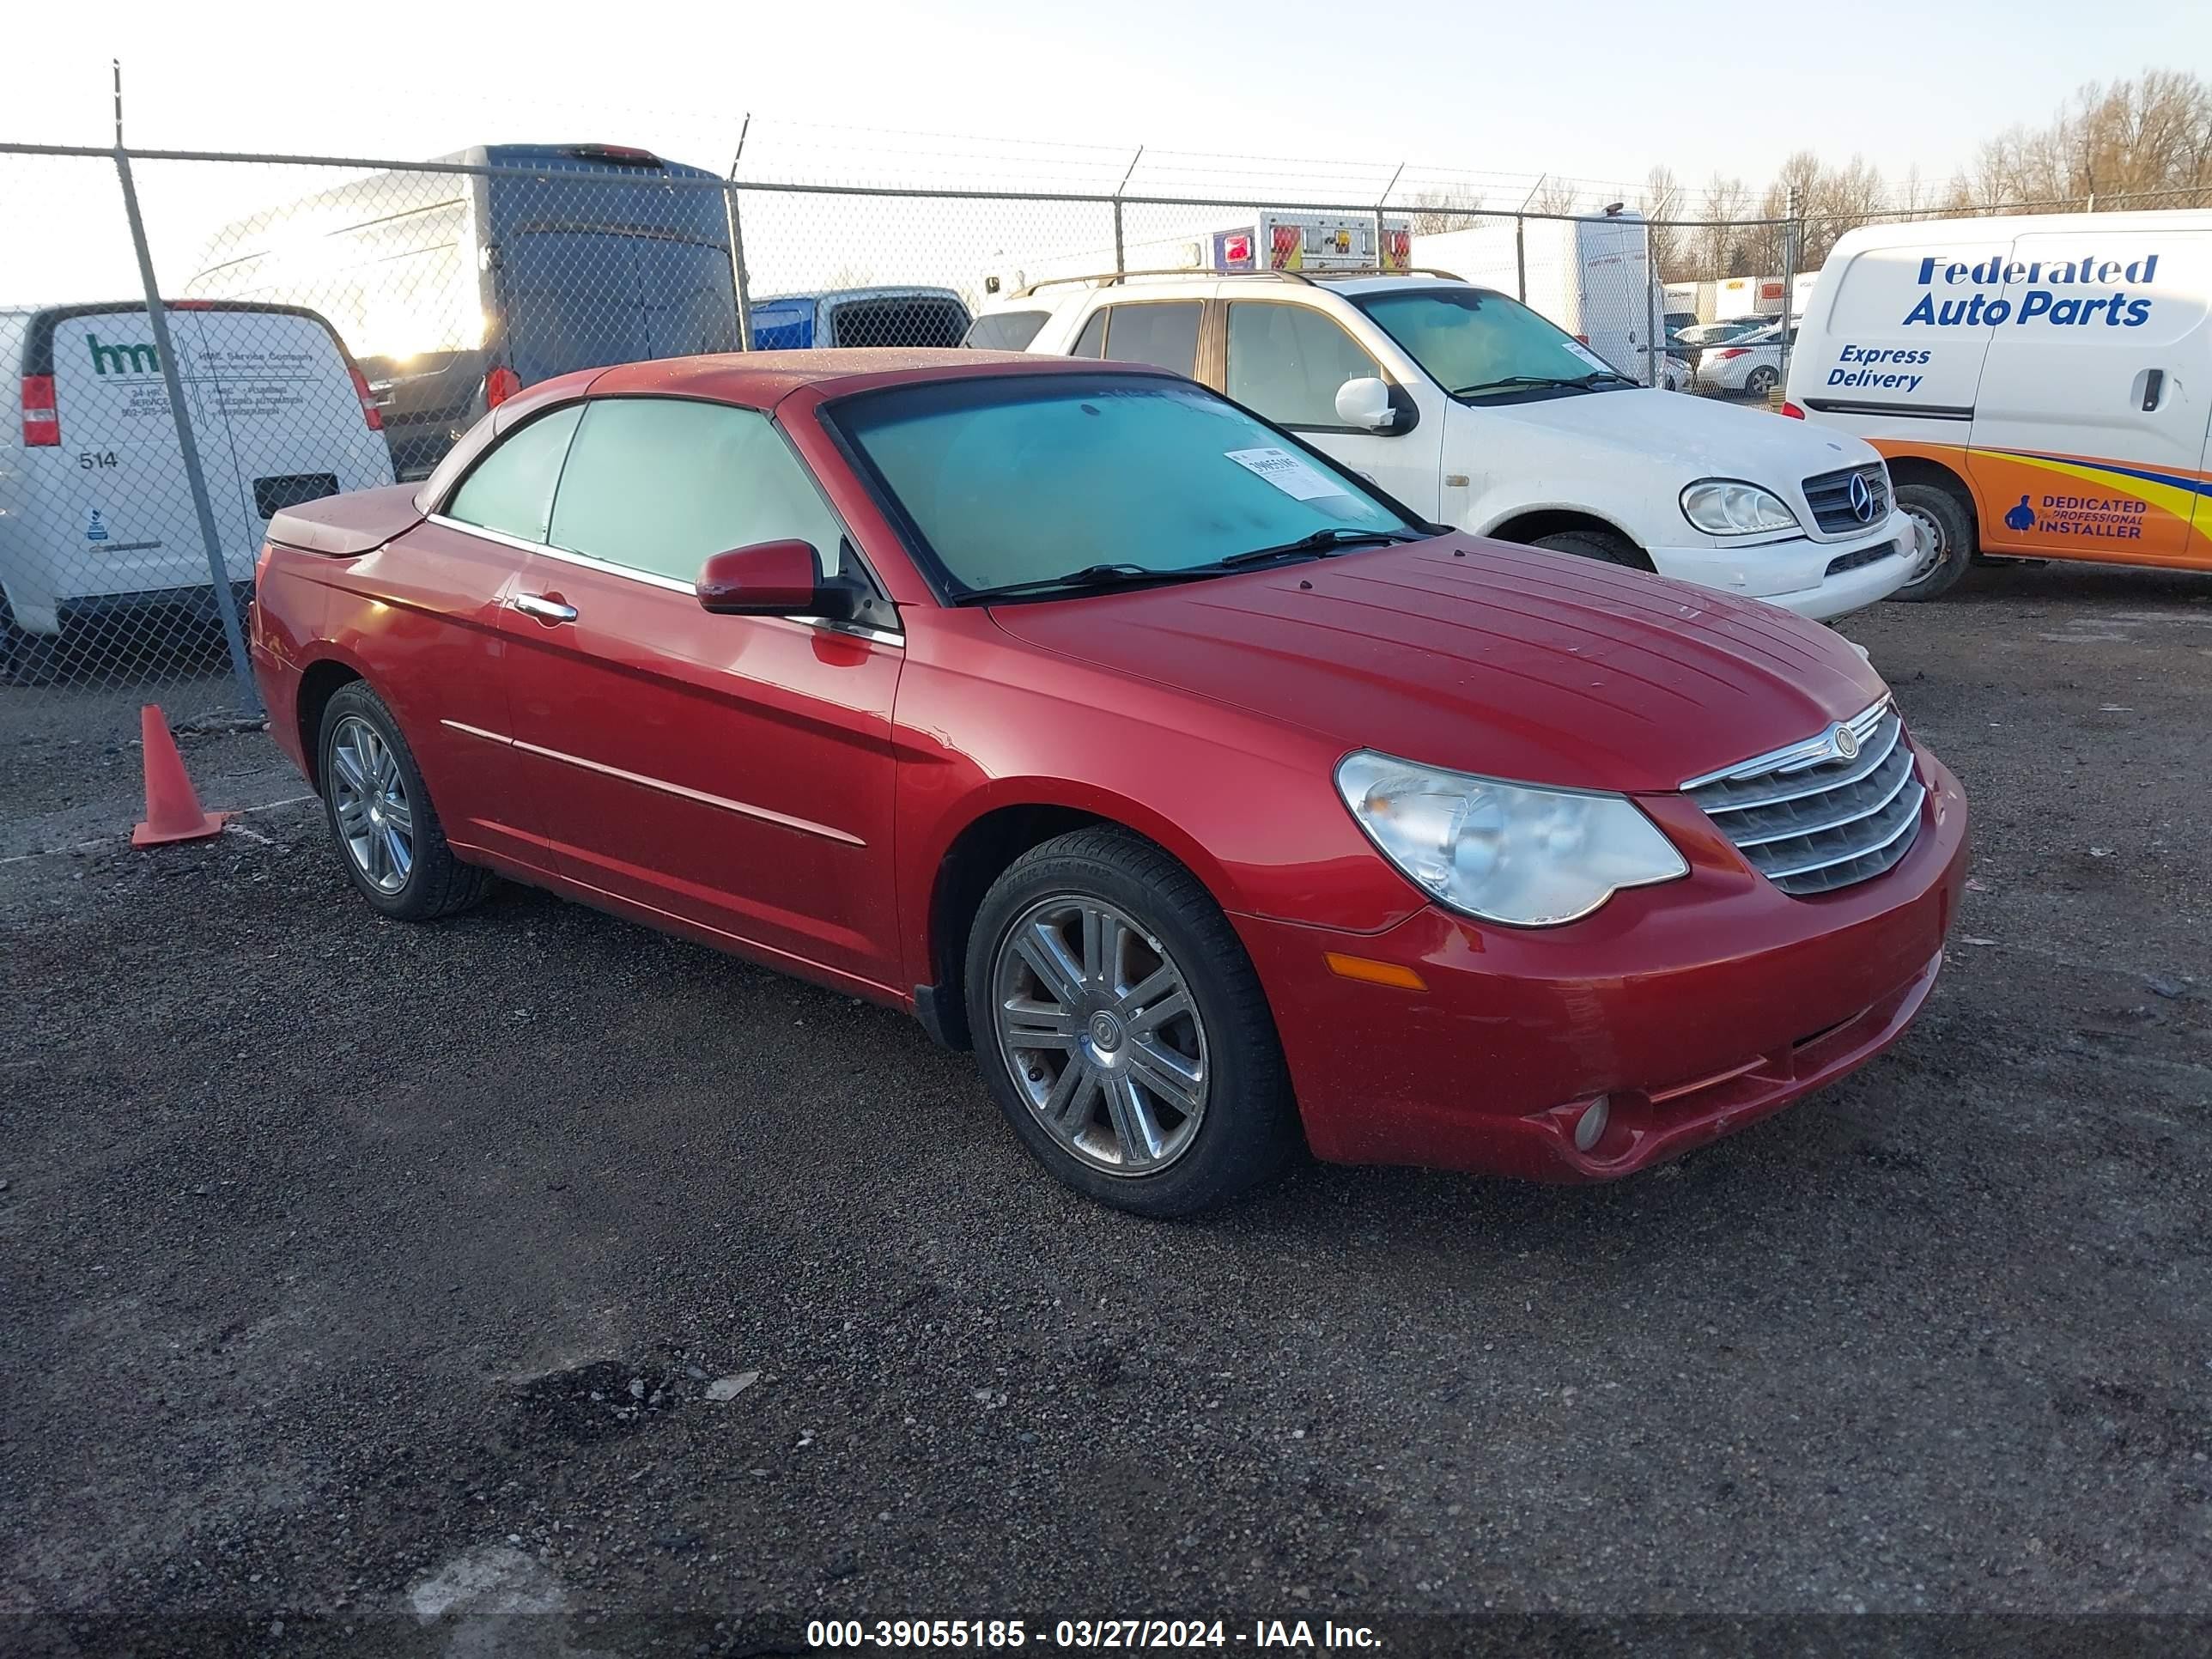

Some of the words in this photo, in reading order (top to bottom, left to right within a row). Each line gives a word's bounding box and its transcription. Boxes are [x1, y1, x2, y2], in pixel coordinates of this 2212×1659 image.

[1917, 254, 2159, 285] Federated
[1902, 291, 2012, 326] Auto
[2015, 290, 2153, 327] Parts
[86, 333, 161, 375] hm
[1839, 344, 1931, 367] Express
[1826, 368, 1924, 392] Delivery
[80, 451, 118, 470] 514
[2043, 495, 2147, 514] DEDICATED
[2053, 509, 2142, 526] PROFESSIONAL
[2039, 520, 2142, 539] INSTALLER
